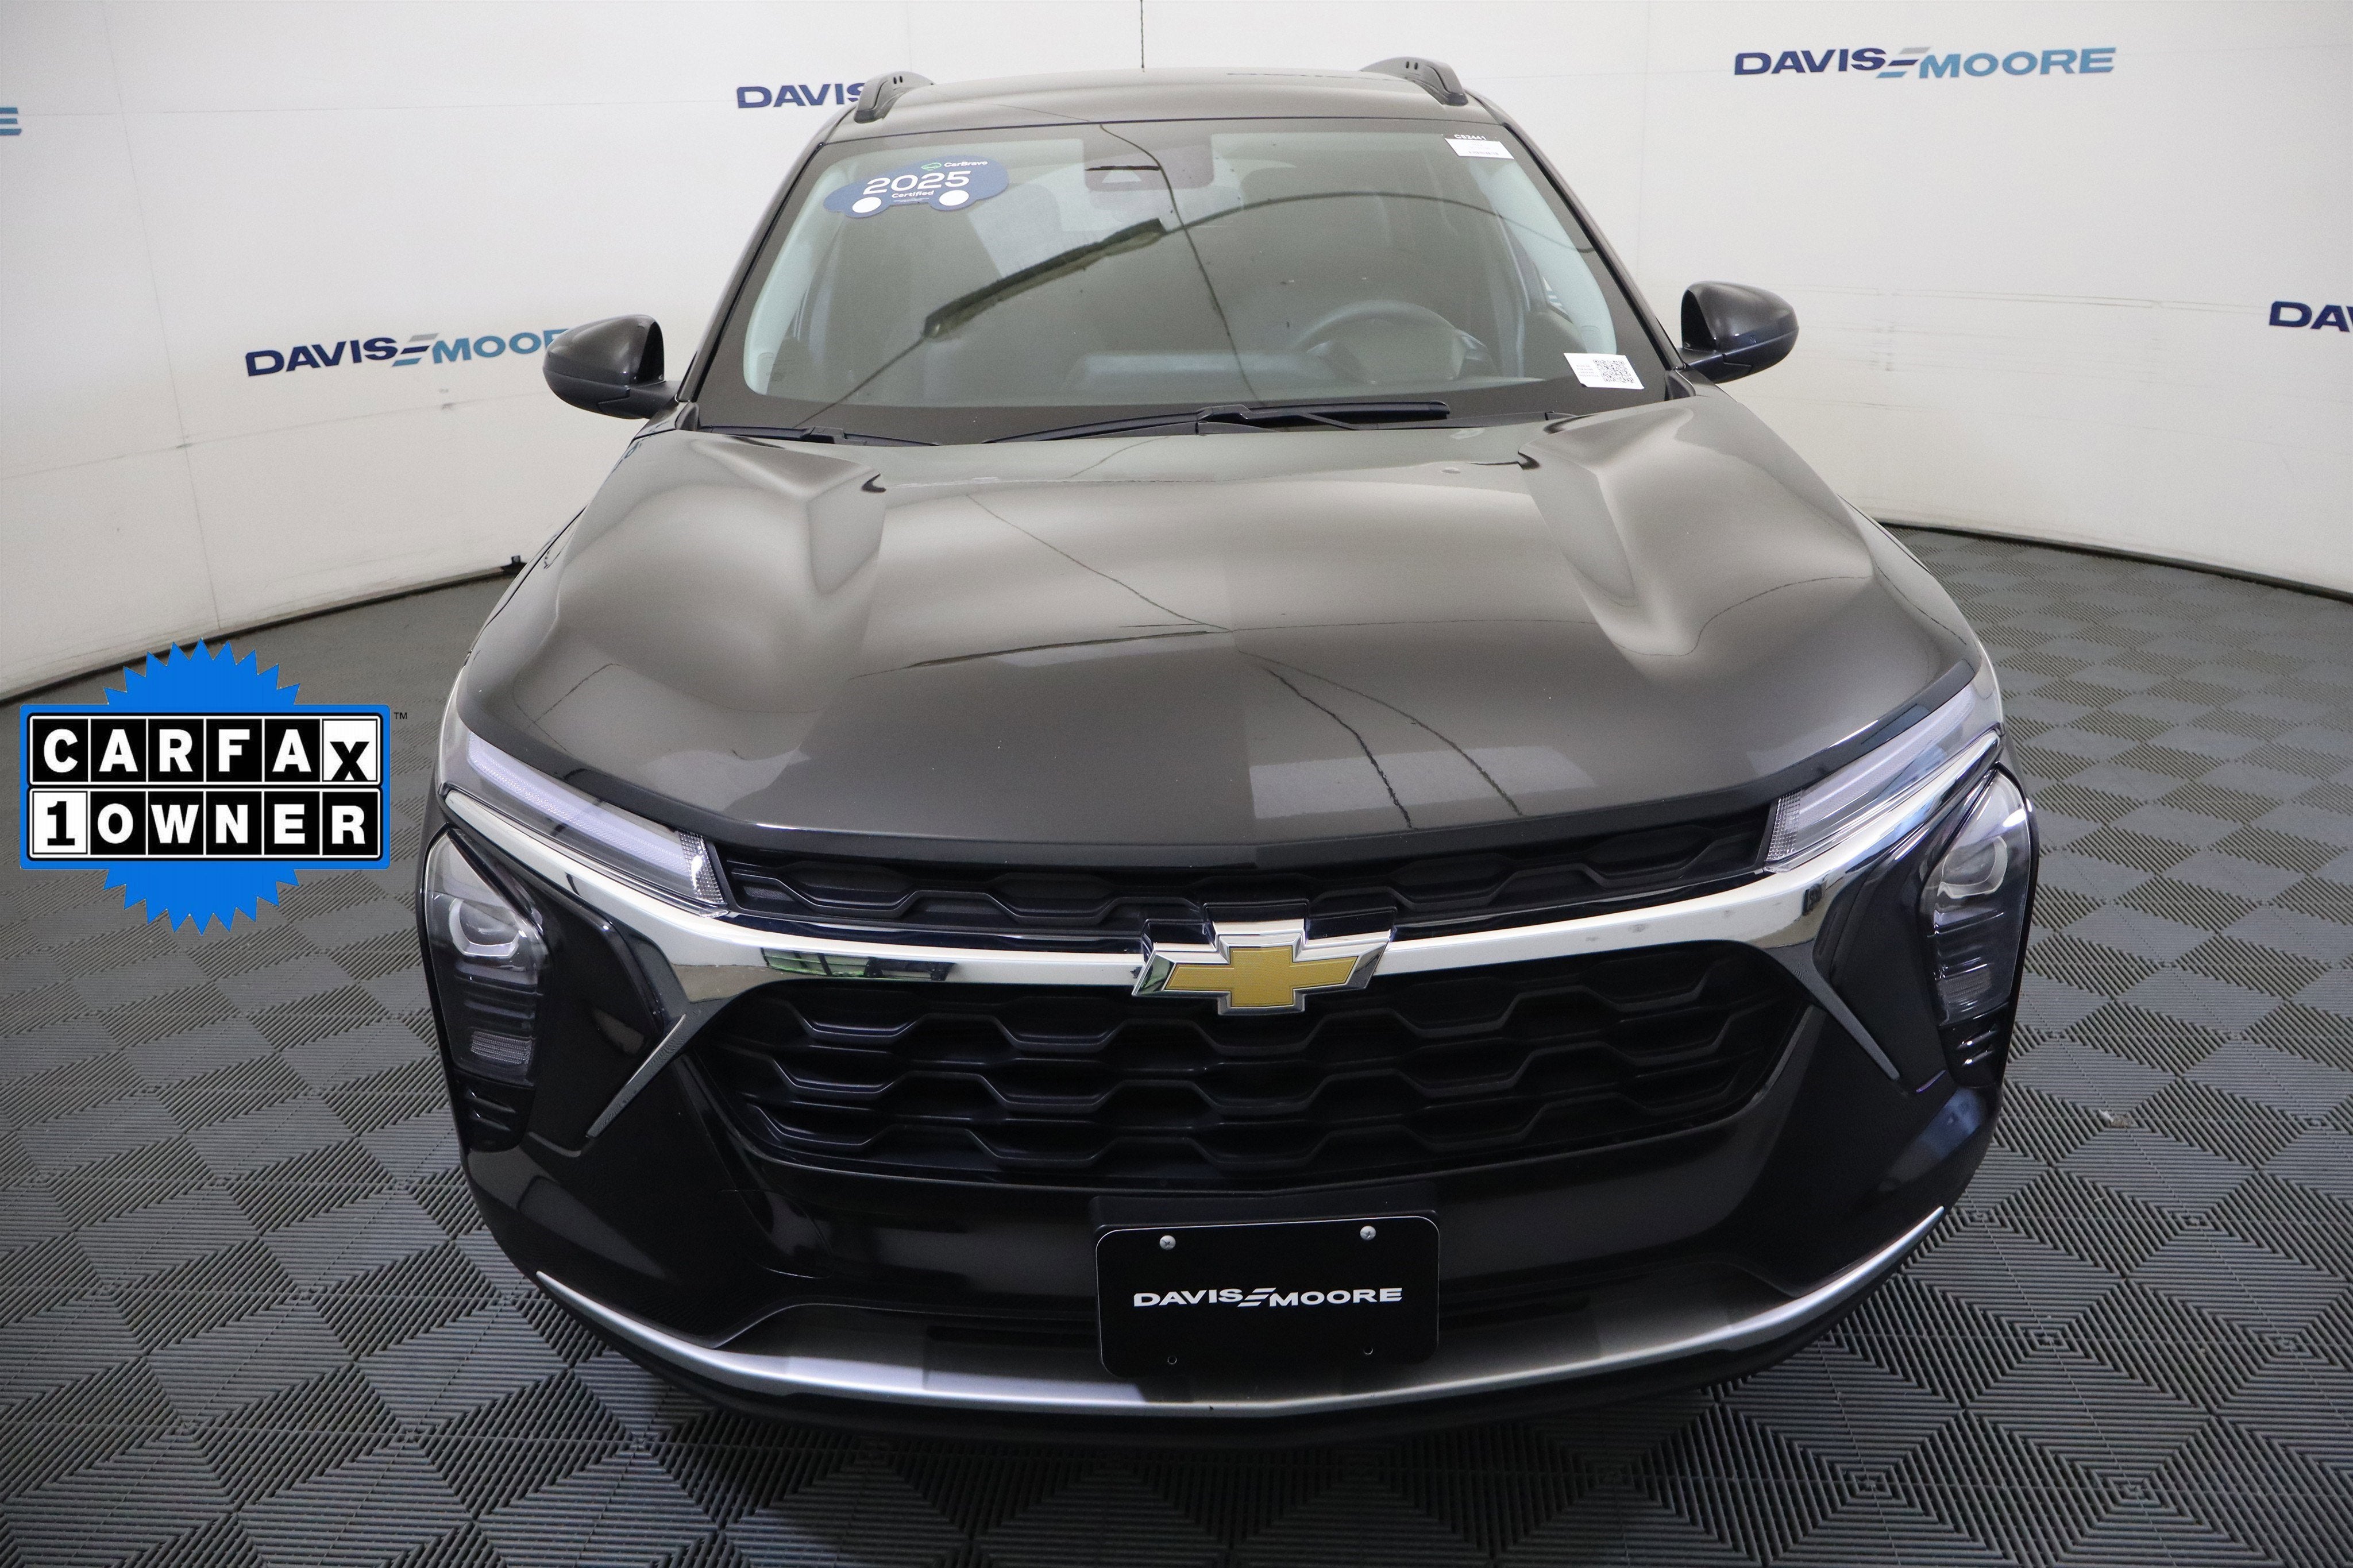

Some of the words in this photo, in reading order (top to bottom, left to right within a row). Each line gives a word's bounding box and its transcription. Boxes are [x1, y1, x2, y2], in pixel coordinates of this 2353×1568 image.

[1734, 48, 1886, 75] DAVIS
[1919, 47, 2116, 79] MOORE
[863, 171, 971, 195] 2025
[892, 190, 935, 198] Certified
[245, 337, 398, 376] DAVIS
[1133, 1288, 1244, 1307] DAVIS
[1269, 1287, 1402, 1307] MOORE
